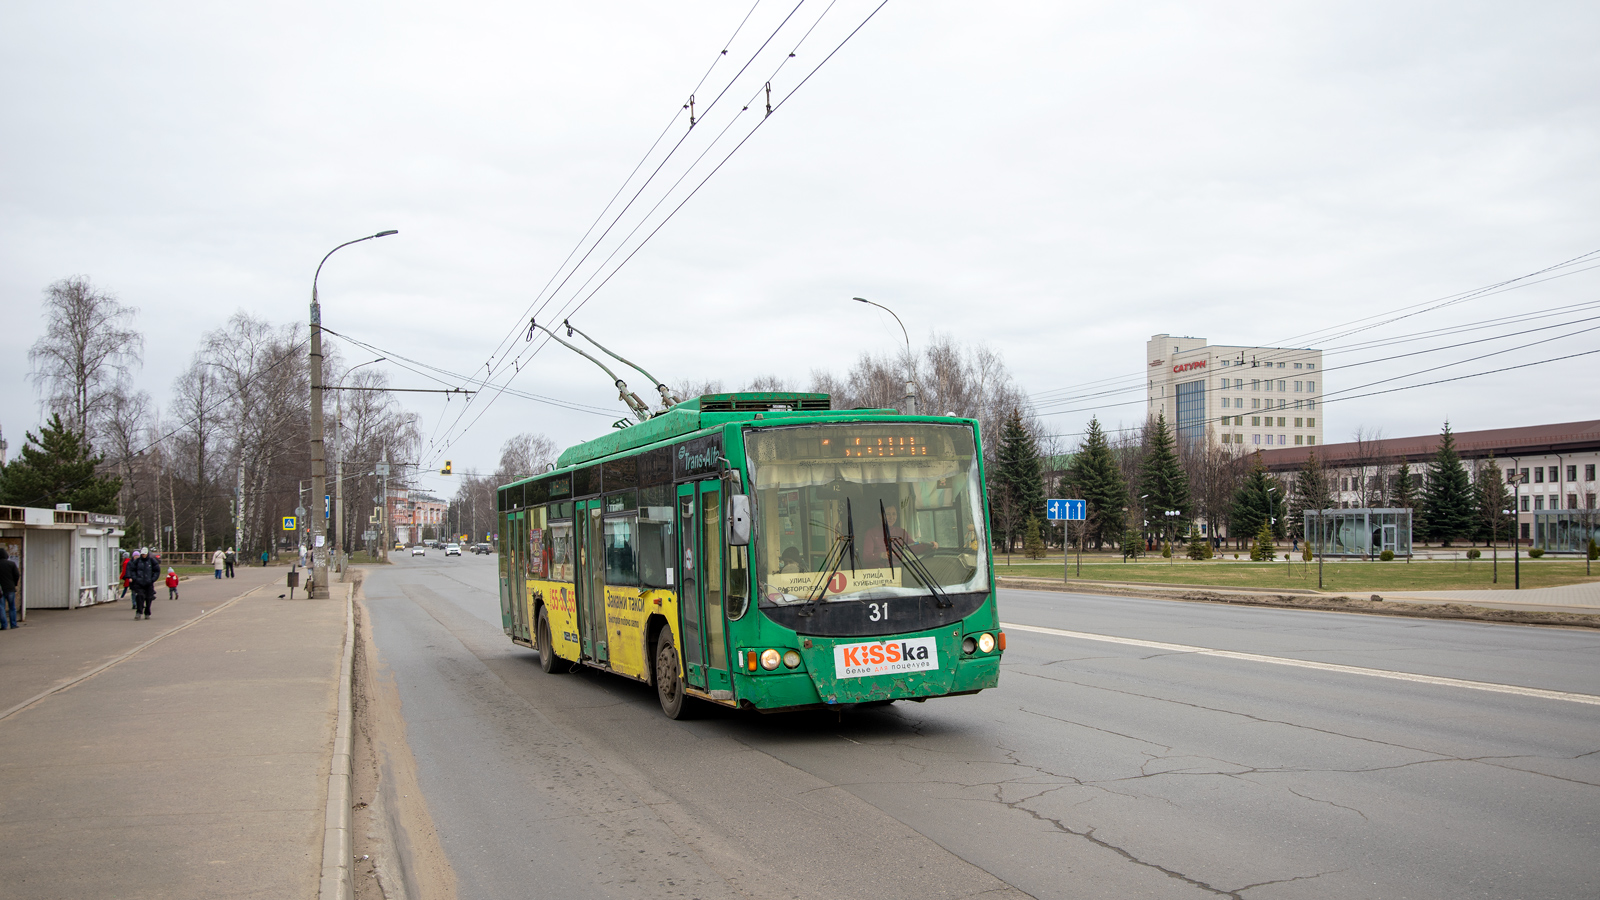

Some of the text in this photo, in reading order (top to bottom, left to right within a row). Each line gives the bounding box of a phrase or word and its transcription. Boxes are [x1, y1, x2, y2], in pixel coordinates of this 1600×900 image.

[1173, 360, 1206, 373] САТУРН
[831, 572, 840, 590] 1
[863, 572, 883, 580] УЛИЦА
[869, 602, 888, 621] 31
[891, 661, 930, 670] поцелуев
